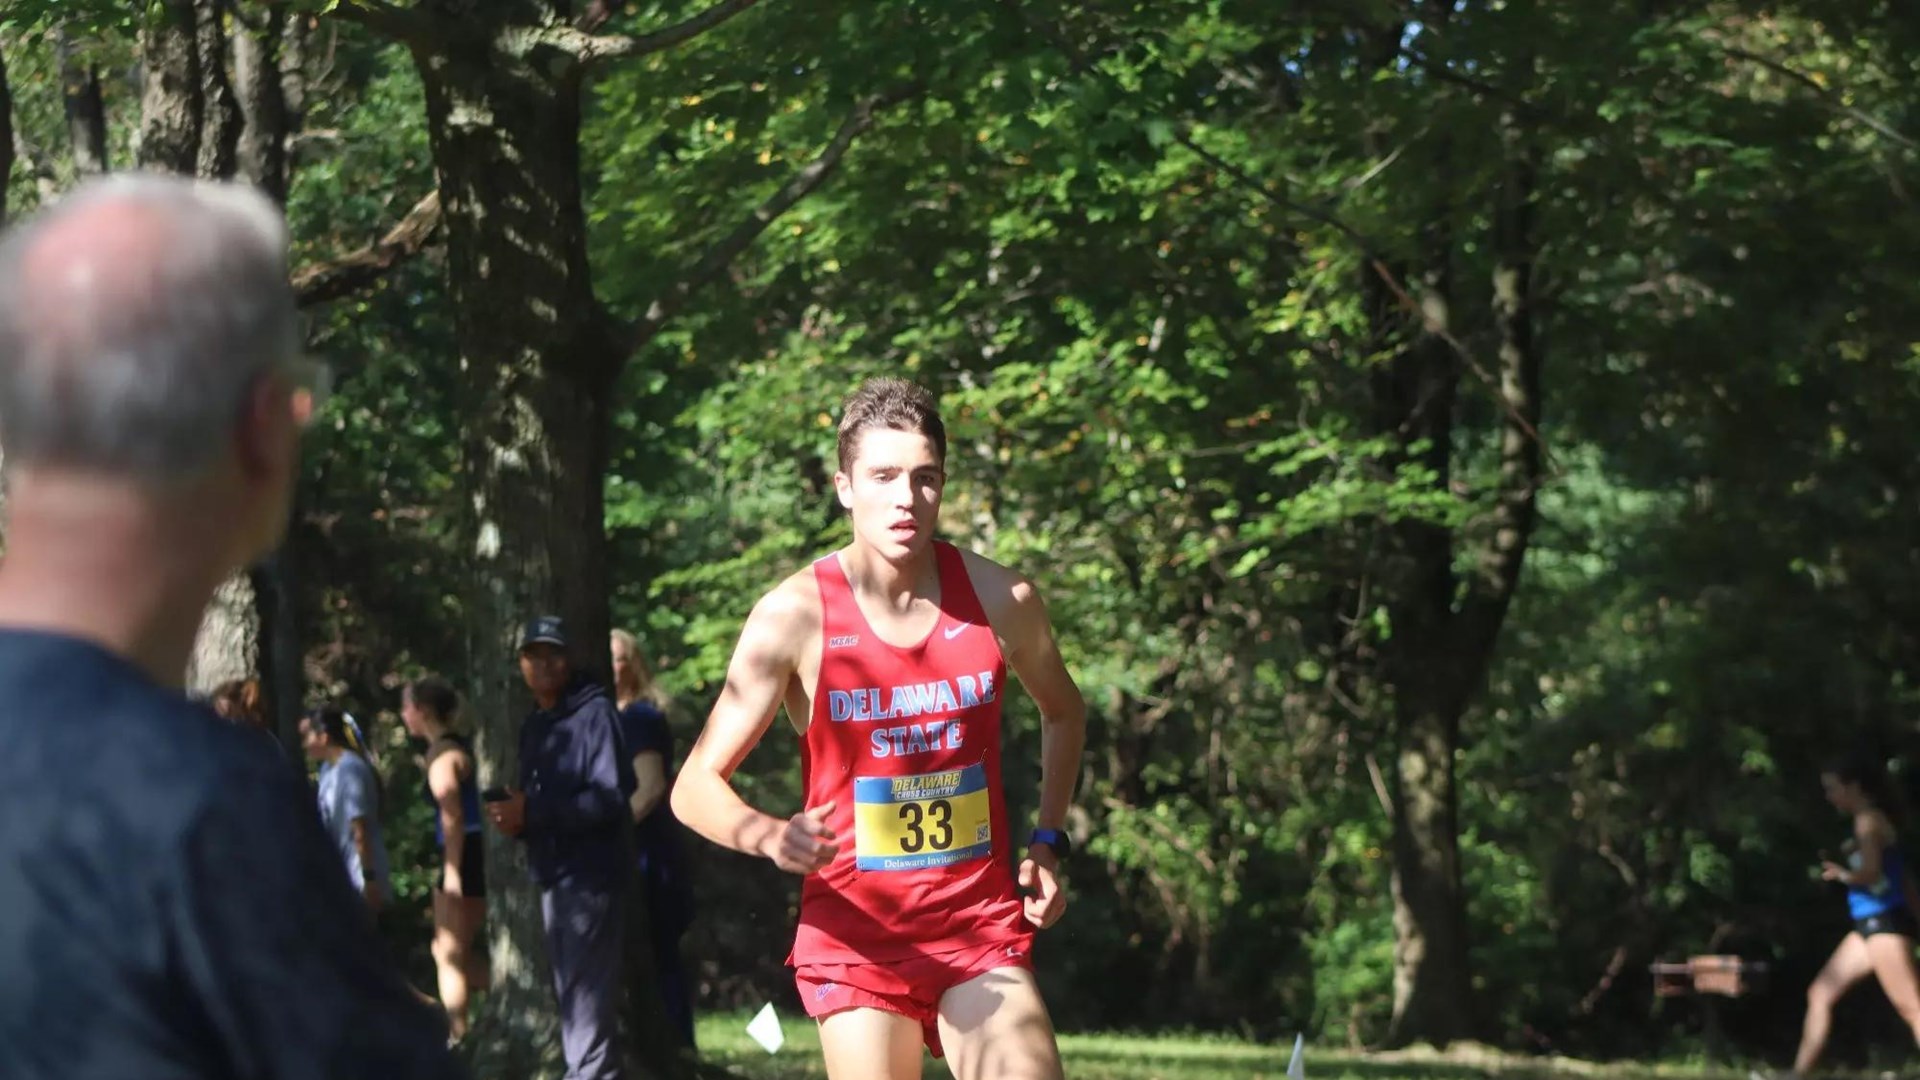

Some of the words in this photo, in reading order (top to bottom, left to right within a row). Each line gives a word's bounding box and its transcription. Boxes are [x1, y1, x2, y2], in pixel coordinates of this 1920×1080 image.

[829, 671, 996, 722] DELAWARE
[871, 718, 964, 758] STATE
[893, 771, 961, 792] DELAWARE
[896, 788, 920, 800] CROSS
[922, 785, 956, 798] COUNTRY
[899, 801, 953, 853] 33
[884, 858, 925, 868] Delaware
[927, 849, 973, 865] Invitational
